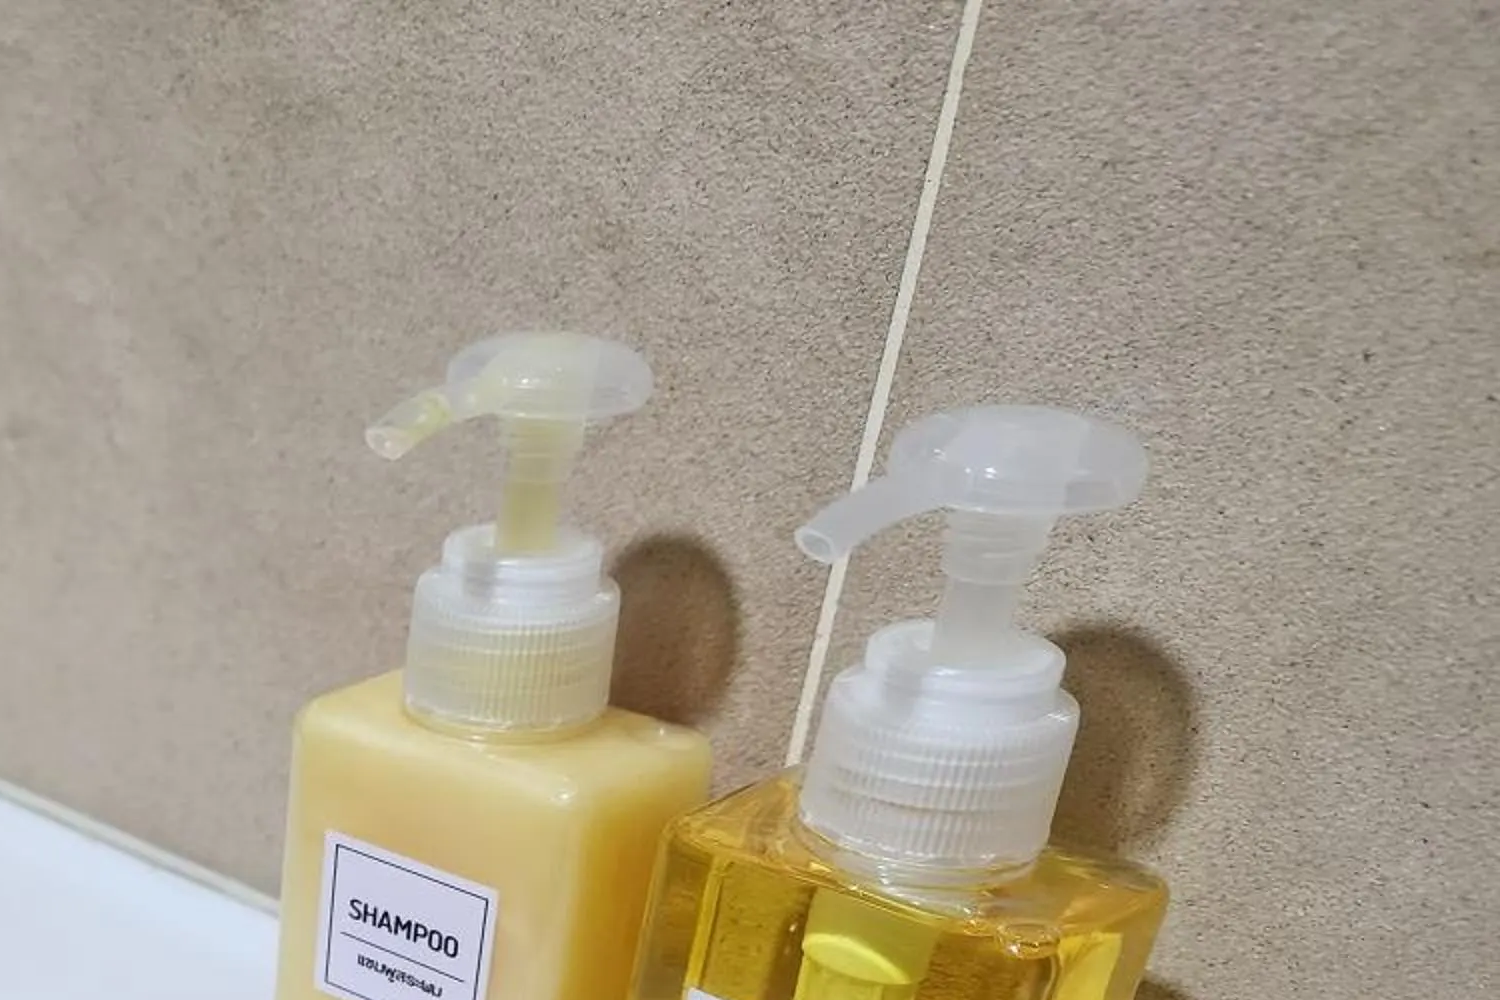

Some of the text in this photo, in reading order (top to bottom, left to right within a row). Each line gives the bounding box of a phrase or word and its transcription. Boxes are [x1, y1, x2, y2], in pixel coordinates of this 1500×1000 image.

[347, 898, 460, 959] SHAMPOO
[356, 953, 444, 998] แชมพูสระผม
